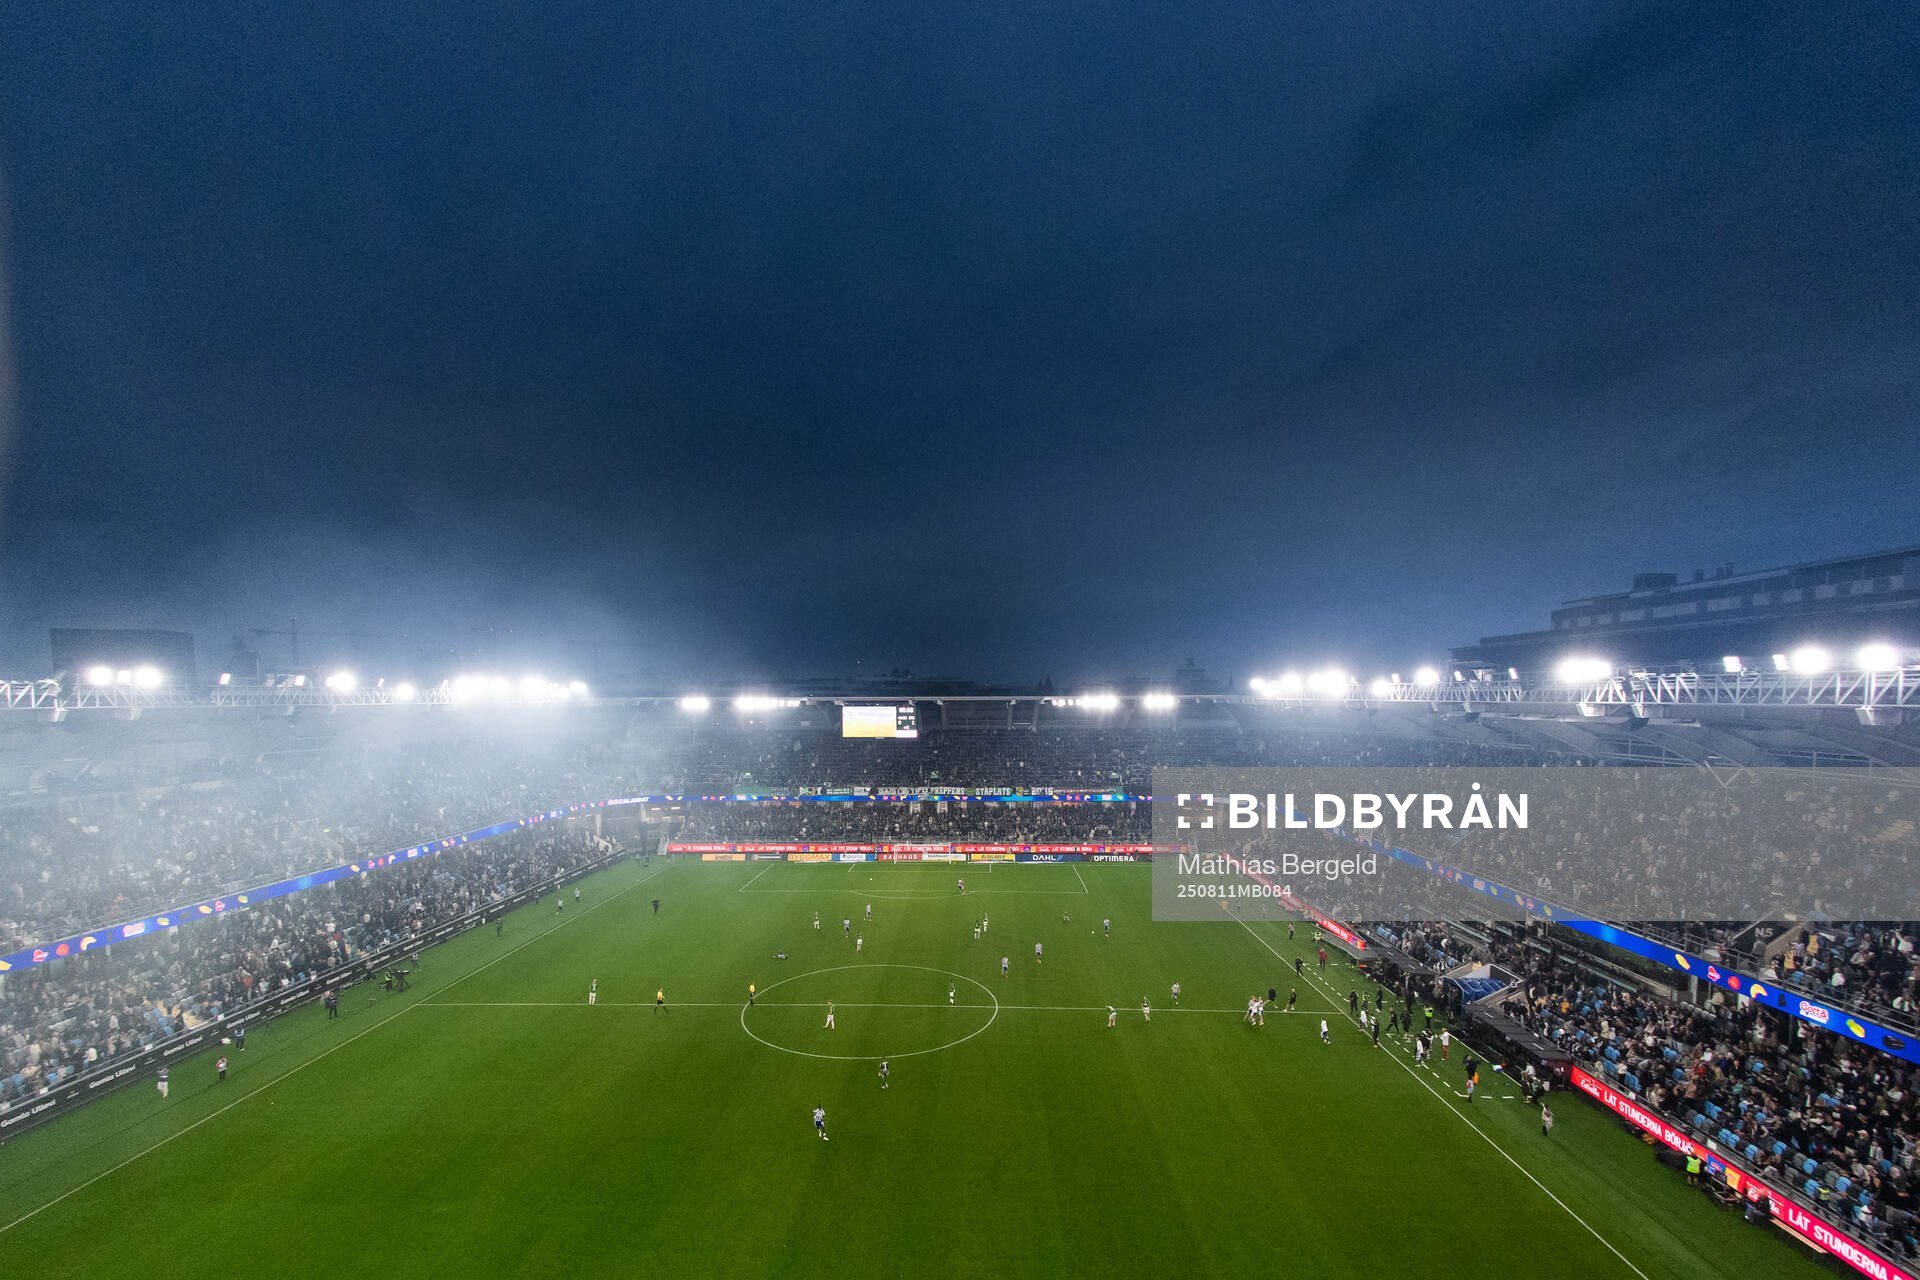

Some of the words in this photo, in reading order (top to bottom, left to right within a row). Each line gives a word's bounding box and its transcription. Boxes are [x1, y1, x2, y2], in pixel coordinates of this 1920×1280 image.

[1604, 1090, 1618, 1107] LÅT
[1619, 1101, 1663, 1137] STUNDERNA
[1788, 1208, 1811, 1231] LÅT
[1813, 1224, 1888, 1280] STUNDERNA
